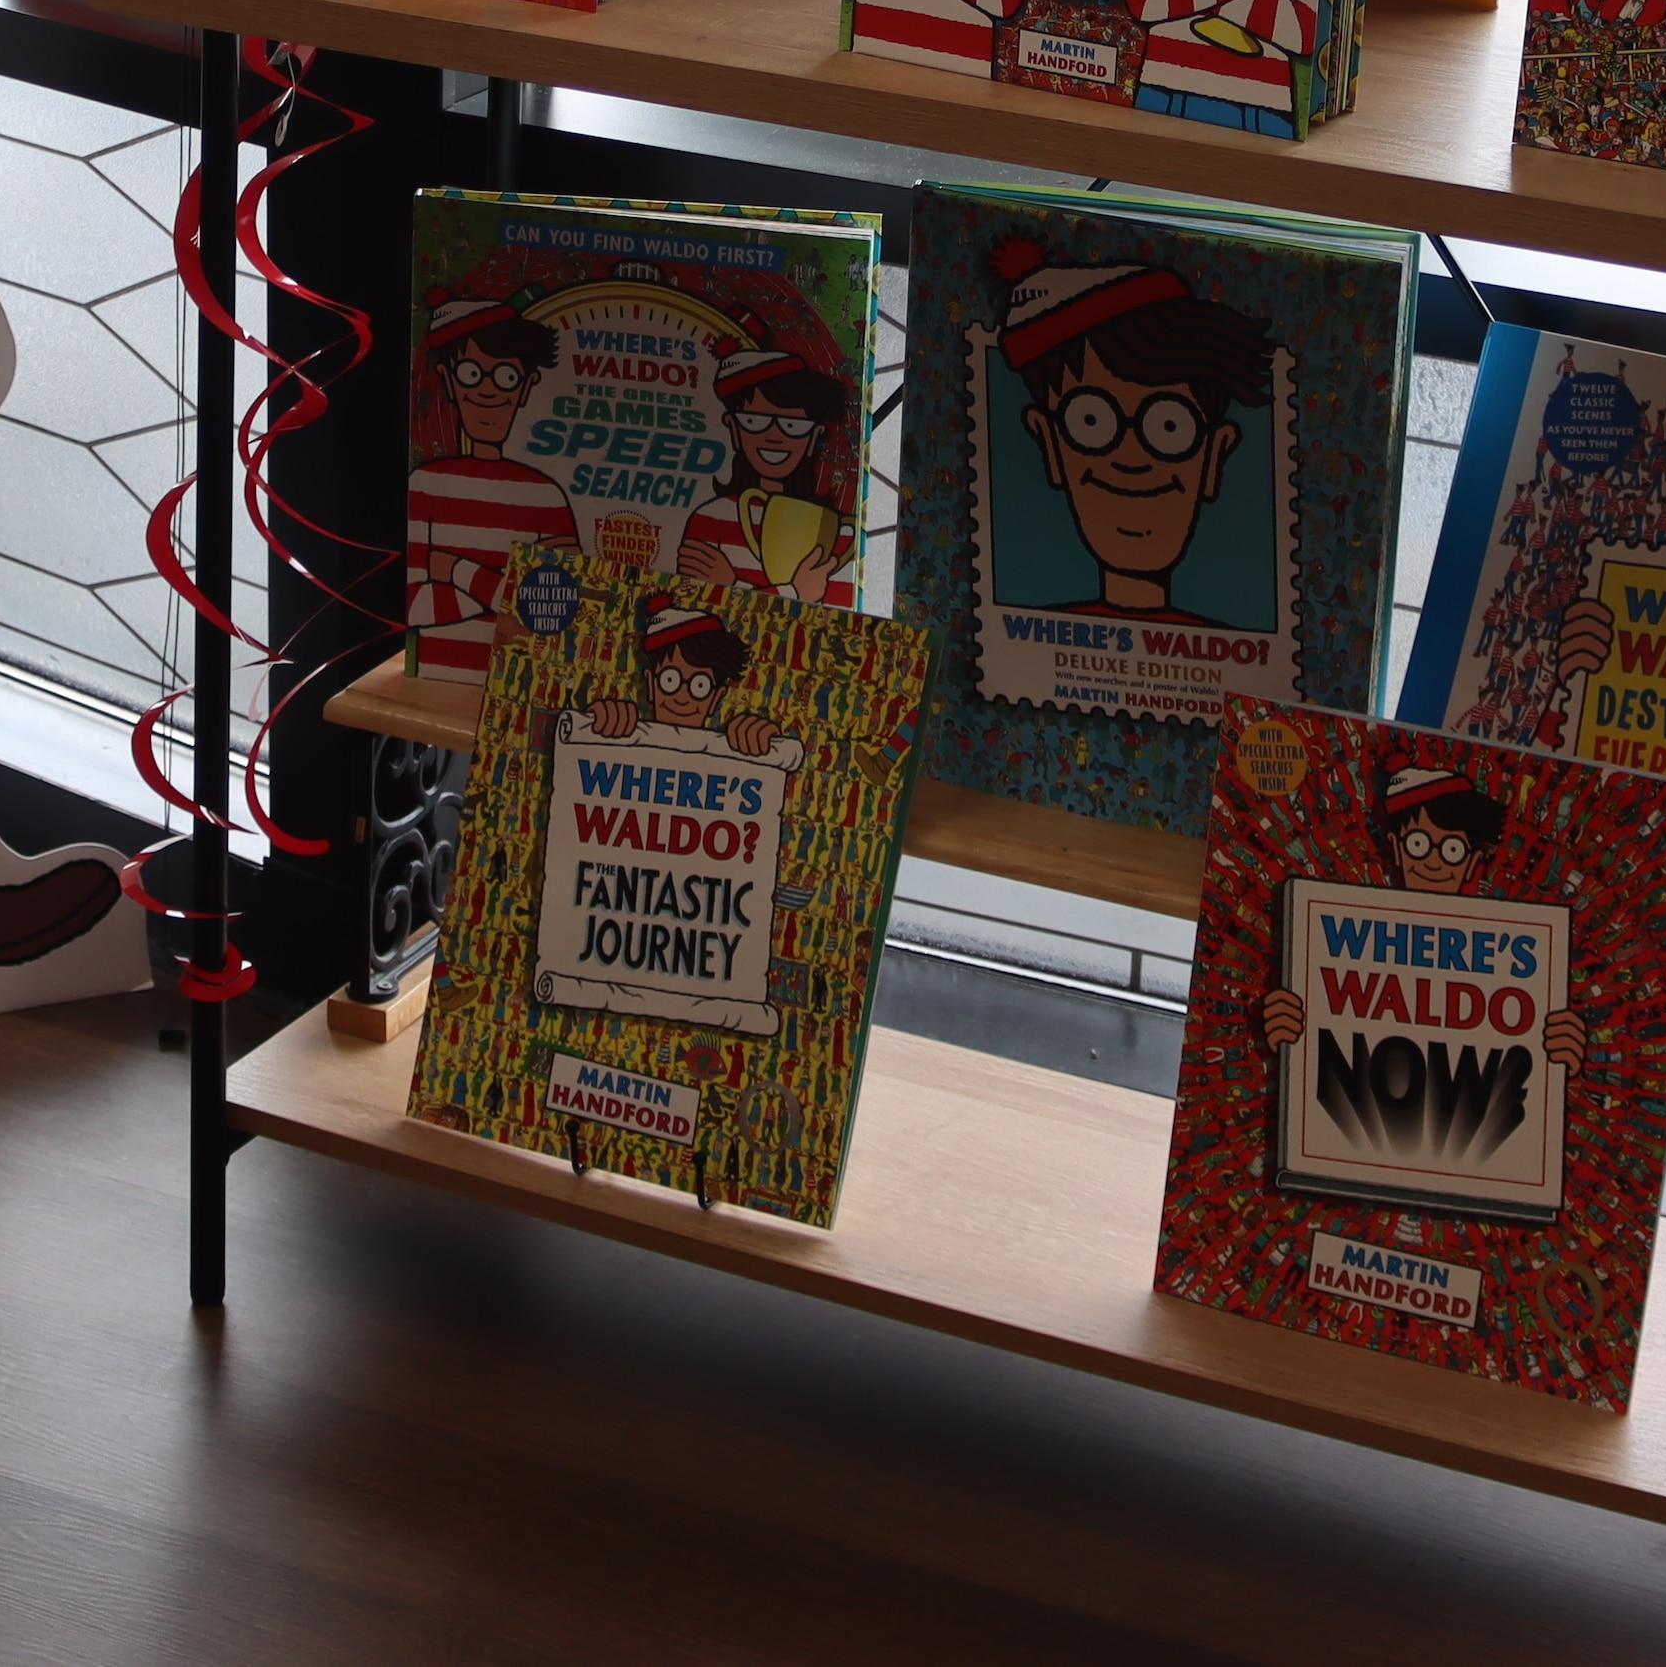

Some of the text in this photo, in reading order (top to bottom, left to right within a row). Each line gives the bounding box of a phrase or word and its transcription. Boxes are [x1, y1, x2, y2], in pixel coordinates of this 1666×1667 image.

[1027, 51, 1108, 79] HANDFORD
[1040, 37, 1096, 61] MARTIN
[576, 329, 696, 361] WHERE'S
[572, 355, 699, 389] WALDO?
[574, 383, 694, 407] THE GREAT
[553, 396, 706, 432] GAMES
[526, 419, 726, 475] SPEED
[569, 464, 697, 509] SEARCH
[1003, 614, 1270, 666] WHERE'S WALDO?
[1055, 652, 1221, 684] DELUXE EDITION
[1054, 685, 1222, 715] MARTIN HANDFORD
[577, 759, 763, 815] WHERE'S
[574, 803, 761, 865] WALDO?
[574, 861, 754, 927] FANTASTIC
[579, 915, 742, 981] JOURNEY
[1320, 914, 1537, 978] WHERE'S
[1320, 966, 1535, 1037] WALDO
[577, 1065, 672, 1108] MARTIN
[1316, 1028, 1533, 1136] NOW?
[551, 1083, 690, 1138] HANDFORD
[1341, 1244, 1449, 1289] MARTIN
[1313, 1263, 1472, 1320] HANDFORD
